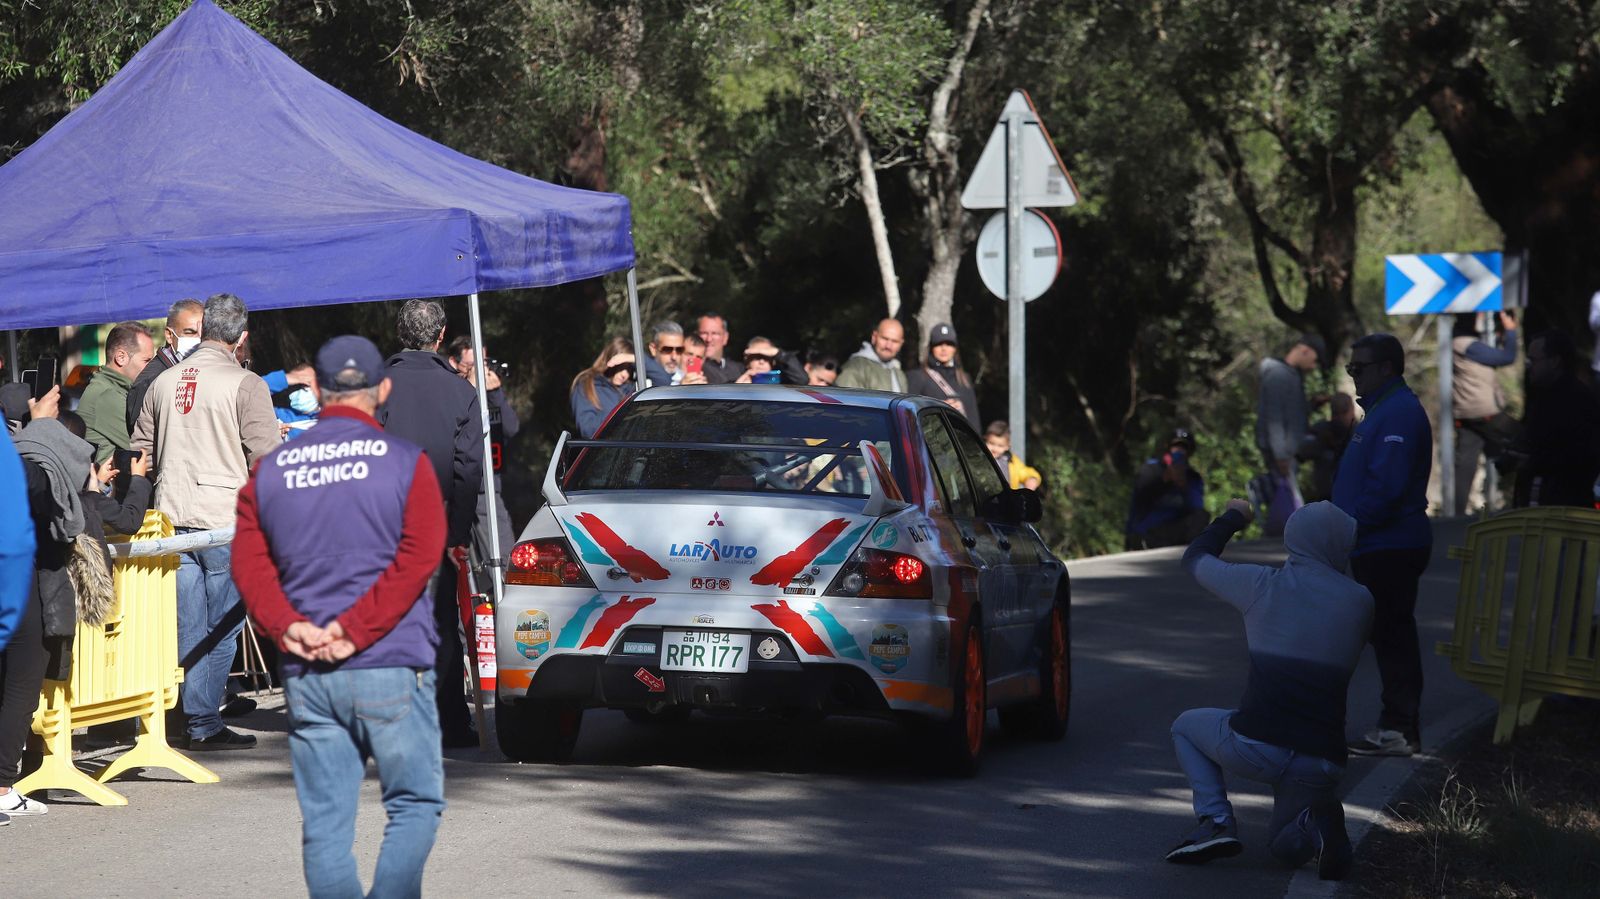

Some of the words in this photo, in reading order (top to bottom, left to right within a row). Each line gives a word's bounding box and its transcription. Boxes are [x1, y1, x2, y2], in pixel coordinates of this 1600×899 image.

[276, 439, 388, 466] COMISARIO
[283, 461, 369, 489] TÉCNICO
[907, 524, 932, 543] BLTZ
[666, 644, 706, 667] RPR
[711, 645, 744, 668] 177
